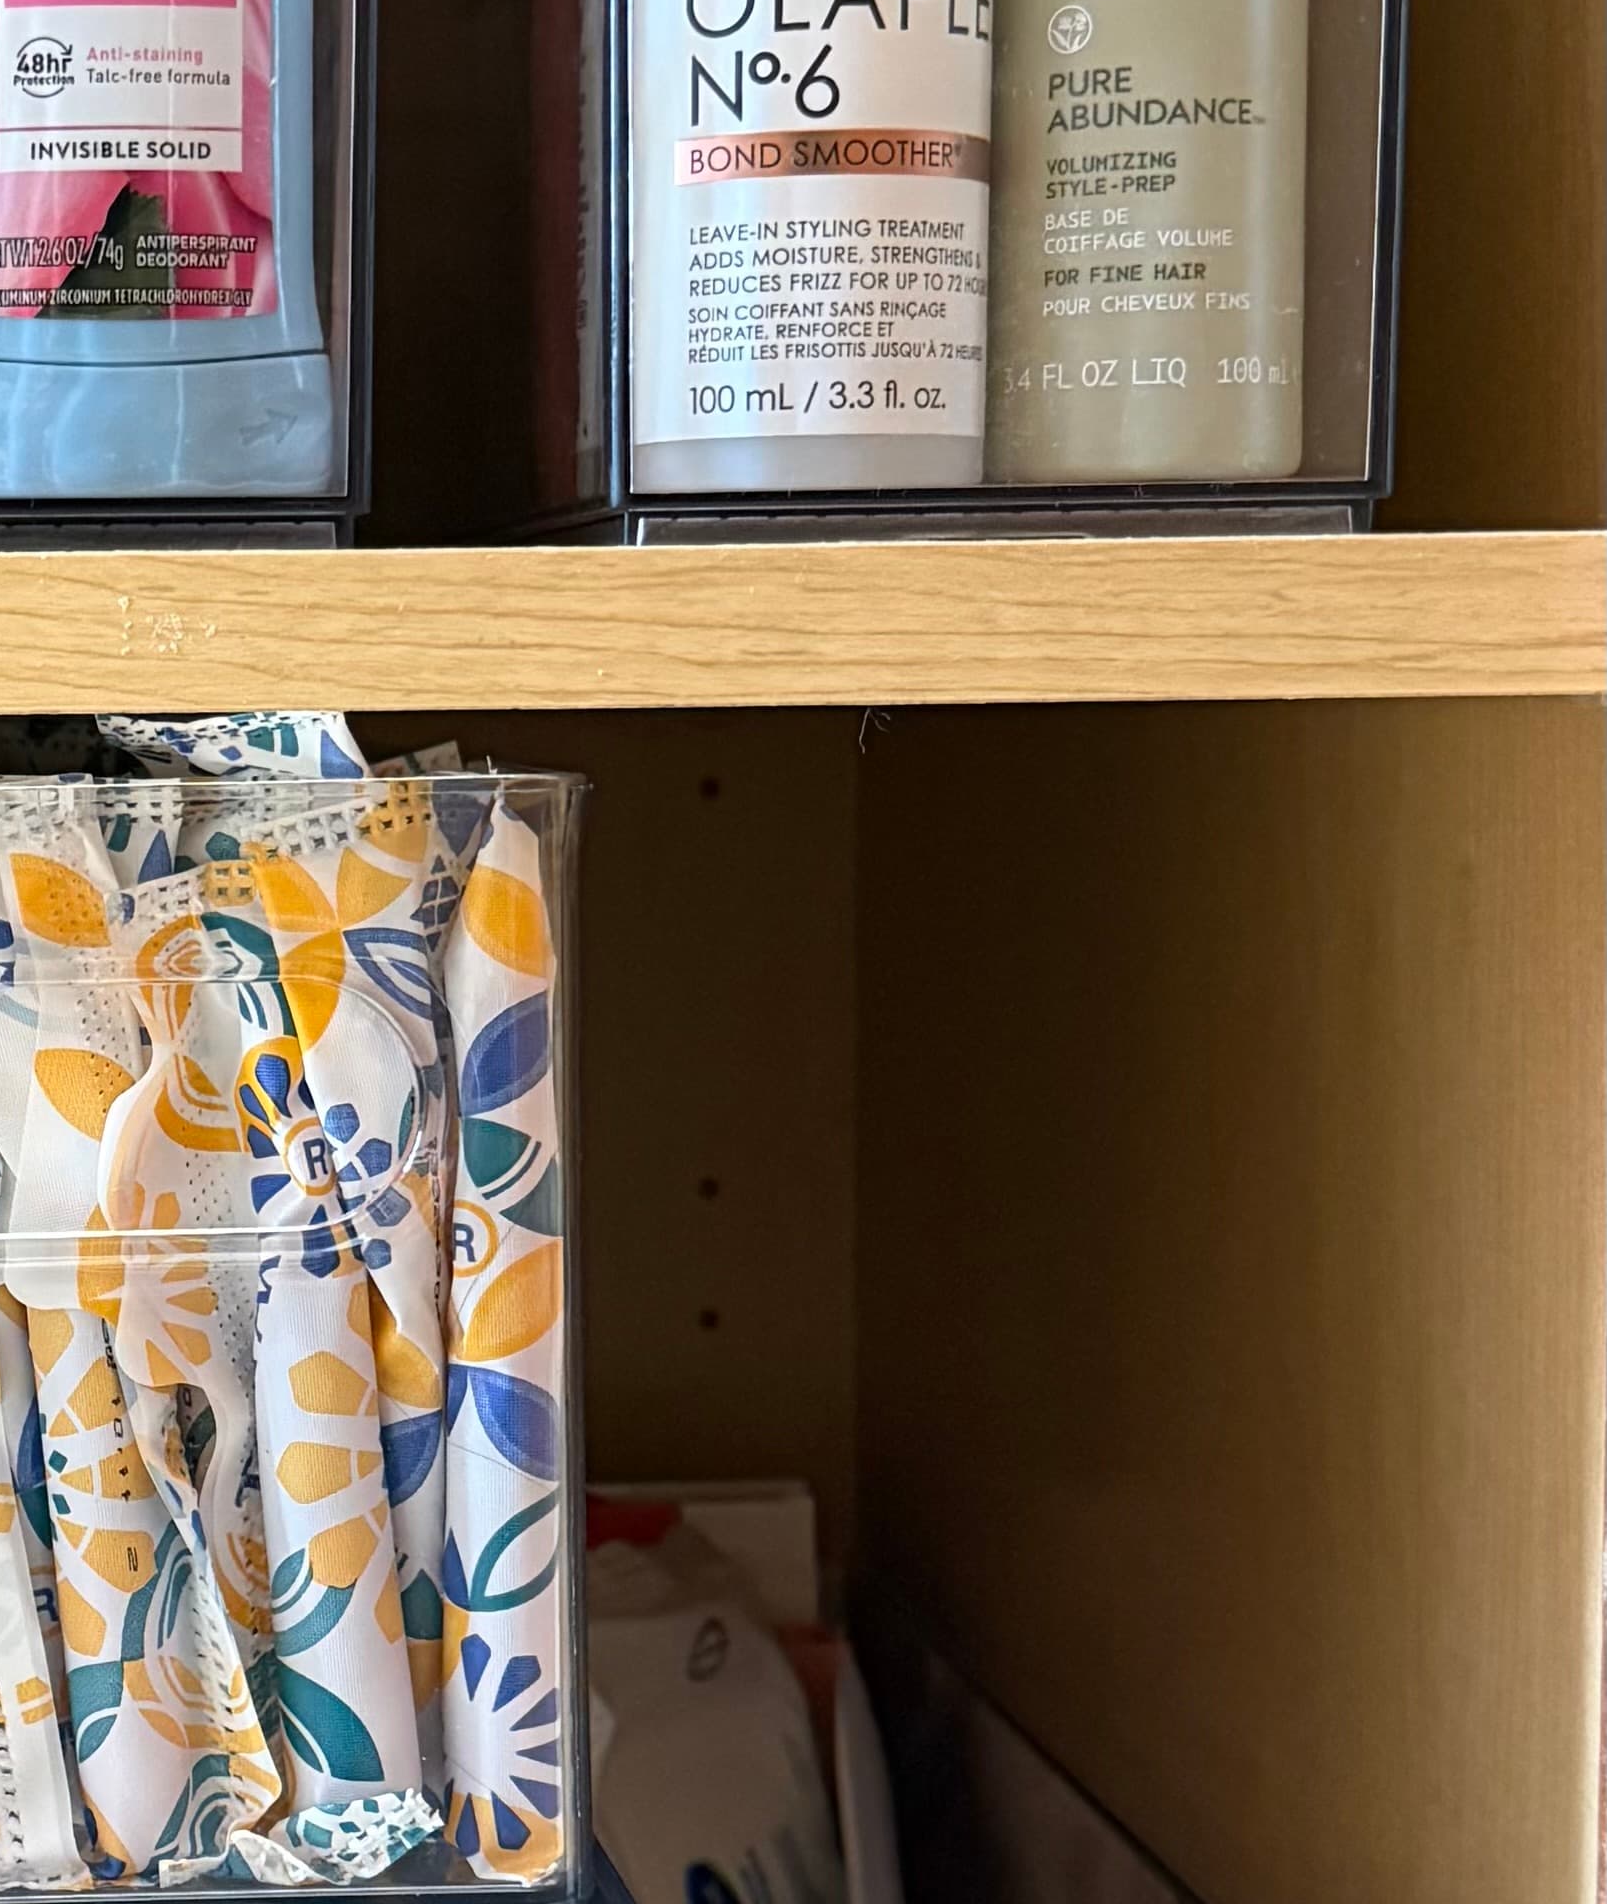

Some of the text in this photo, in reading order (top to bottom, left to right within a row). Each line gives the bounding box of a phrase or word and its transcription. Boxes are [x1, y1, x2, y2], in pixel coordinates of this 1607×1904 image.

[16, 51, 74, 76] 48hr
[86, 46, 204, 65] Anti-staining
[12, 73, 76, 88] Protection
[87, 68, 231, 86] Talc-free formula
[1048, 66, 1132, 100] PURE
[30, 141, 212, 161] INVISIBLE SOLID
[690, 142, 782, 175] BOND
[1046, 151, 1178, 176] VOLUMIZING
[1045, 174, 1177, 199] STYLE-PREP
[690, 219, 966, 246] LEAVE-IN STYLING TREATMENT
[1044, 208, 1130, 232] BASE DE
[136, 235, 257, 252] ANTIPERSPIRANT
[1044, 228, 1234, 256] COIFFAGE VOLUME
[136, 251, 228, 267] DEODORANT
[690, 251, 744, 272] ADDS
[752, 247, 864, 268] MOISTURE,
[870, 246, 974, 269] STRENGTHENS
[690, 274, 782, 297] REDUCES
[790, 272, 842, 292] FRIZZ
[850, 271, 889, 291] FOR
[896, 272, 918, 292] UP
[925, 273, 944, 293] TO
[947, 274, 963, 294] 72
[1044, 262, 1207, 289] FOR FINE HAIR
[688, 300, 947, 324] SOIN COIFFANT SANS RINÇAGE
[1042, 292, 1251, 318] POUR CHEVEUX FINS
[776, 321, 873, 340] RENFORCE
[877, 321, 895, 337] ET
[688, 342, 745, 365] RÉDUIT
[750, 344, 779, 361] LES
[785, 341, 867, 360] FRISOTTIS
[940, 343, 955, 359] 72
[1042, 363, 1074, 390] FL
[1081, 360, 1119, 387] OZ
[1132, 357, 1187, 388] LIQ
[1216, 357, 1262, 384] 100
[690, 379, 947, 415] 100 mL / 3.3 fl. oz.
[304, 1137, 330, 1181] R
[454, 1226, 476, 1263] R
